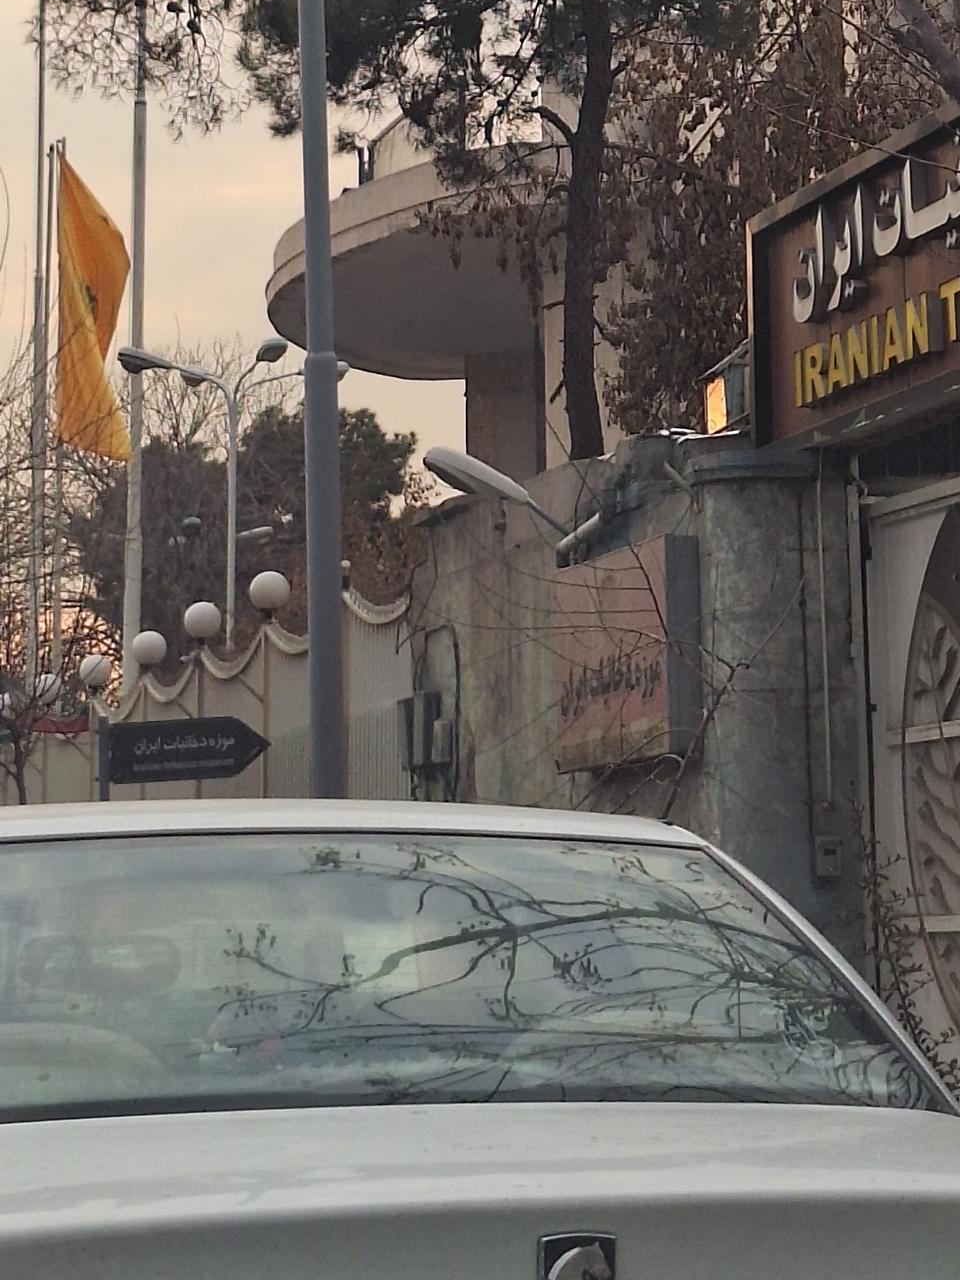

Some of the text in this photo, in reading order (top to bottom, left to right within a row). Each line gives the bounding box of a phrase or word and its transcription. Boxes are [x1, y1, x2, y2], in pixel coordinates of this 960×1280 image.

[793, 183, 863, 323] ایران
[795, 292, 929, 407] IRANIAN
[134, 735, 161, 755] ایران
[209, 733, 236, 752] موزه
